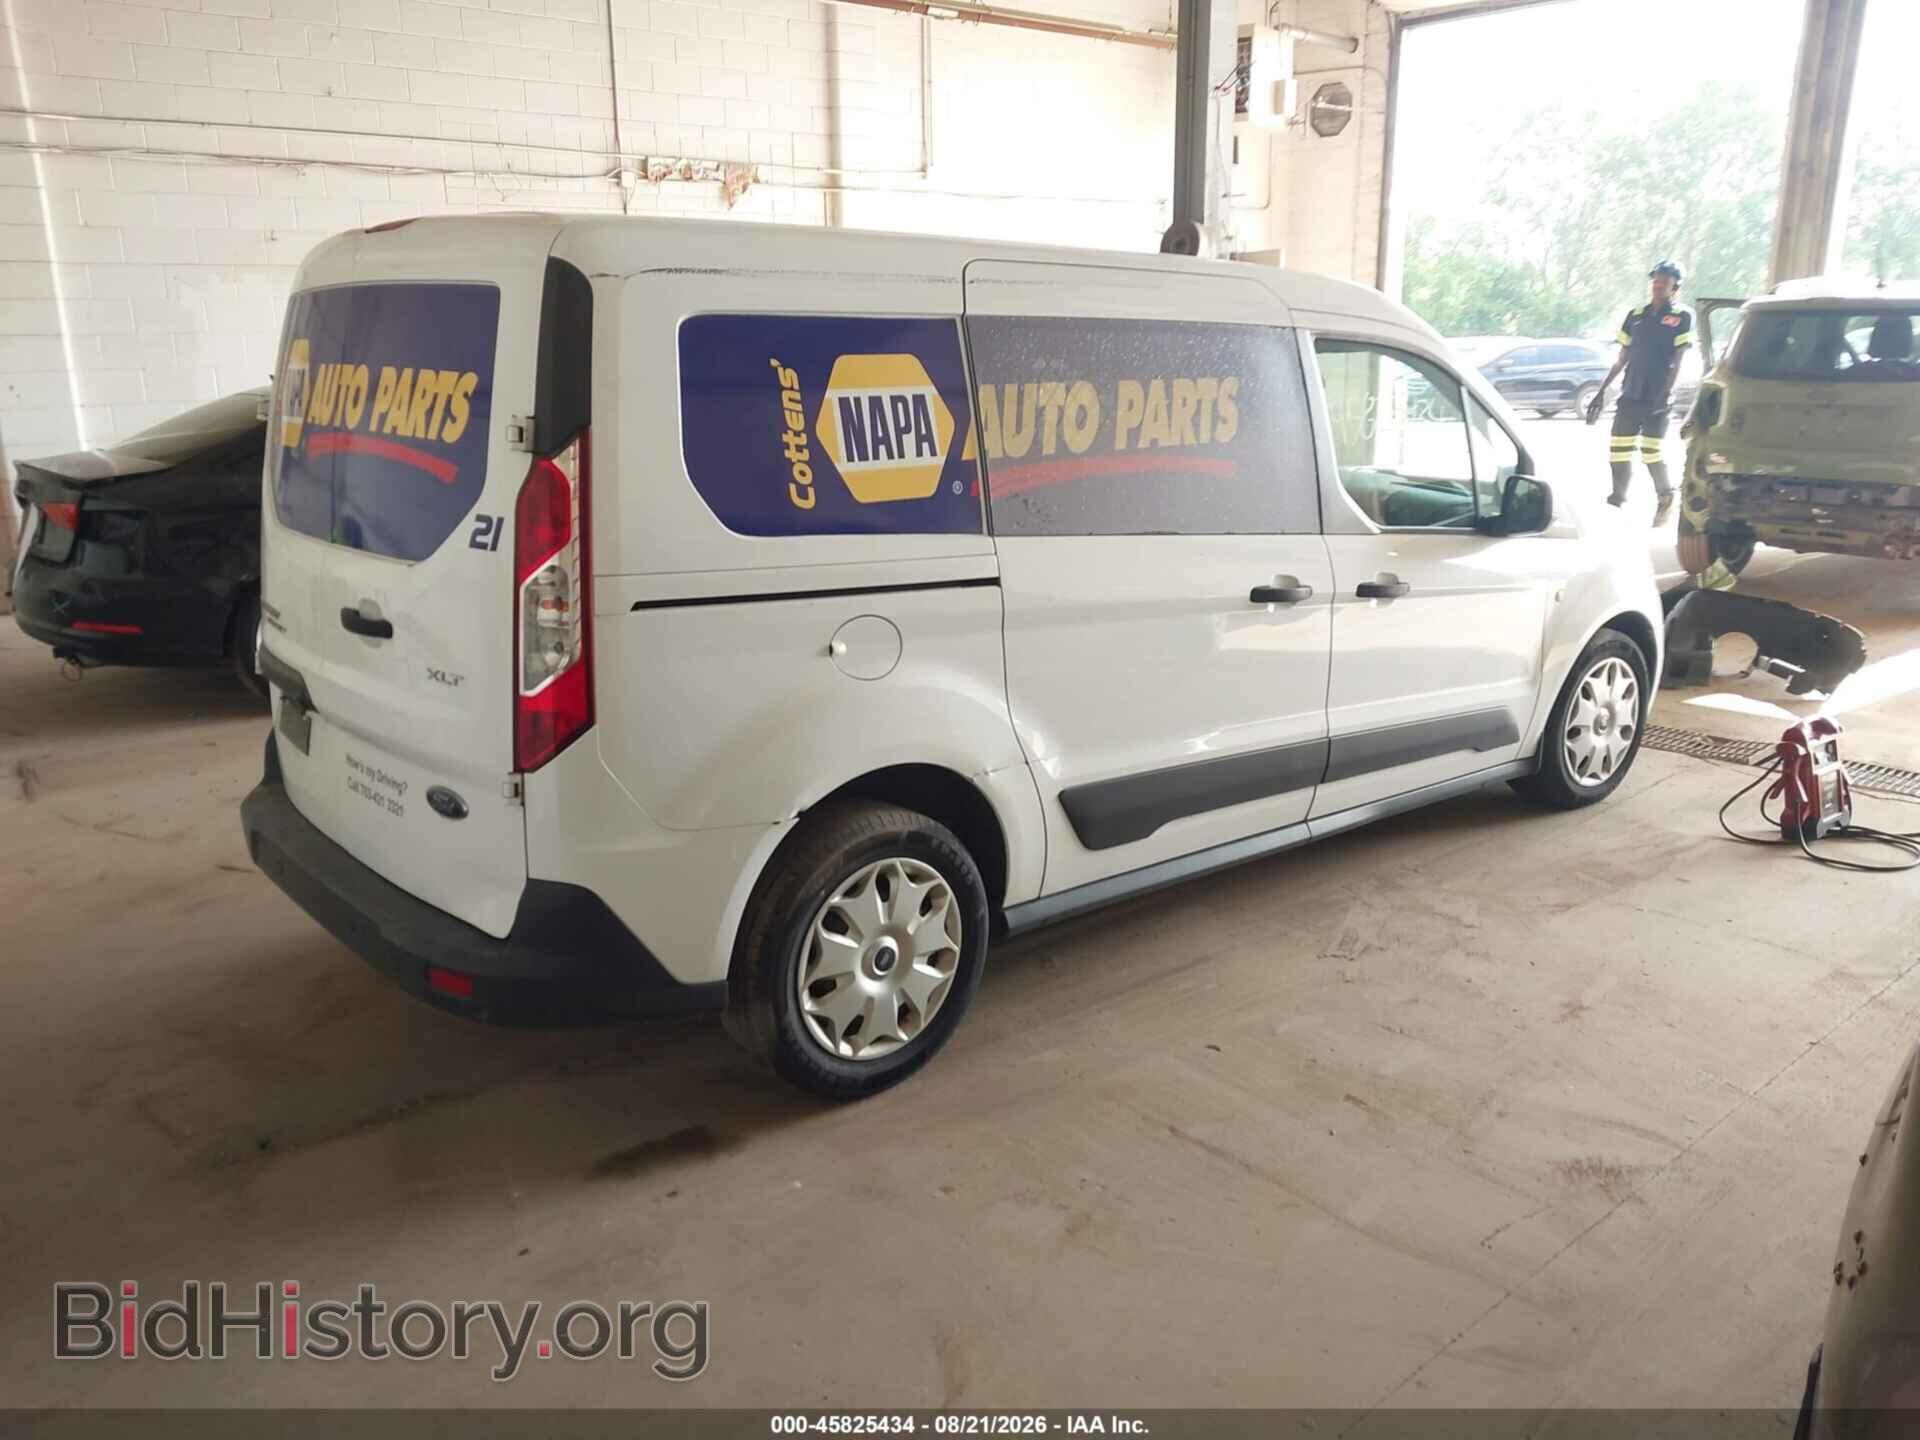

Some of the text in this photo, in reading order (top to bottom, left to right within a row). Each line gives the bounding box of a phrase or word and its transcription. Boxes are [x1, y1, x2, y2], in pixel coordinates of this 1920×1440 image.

[307, 363, 370, 430] AUTO
[368, 366, 478, 444] PARTS
[838, 376, 1240, 463] NAPA AUTO PARTS
[469, 514, 504, 551] 21
[426, 667, 465, 687] XLT
